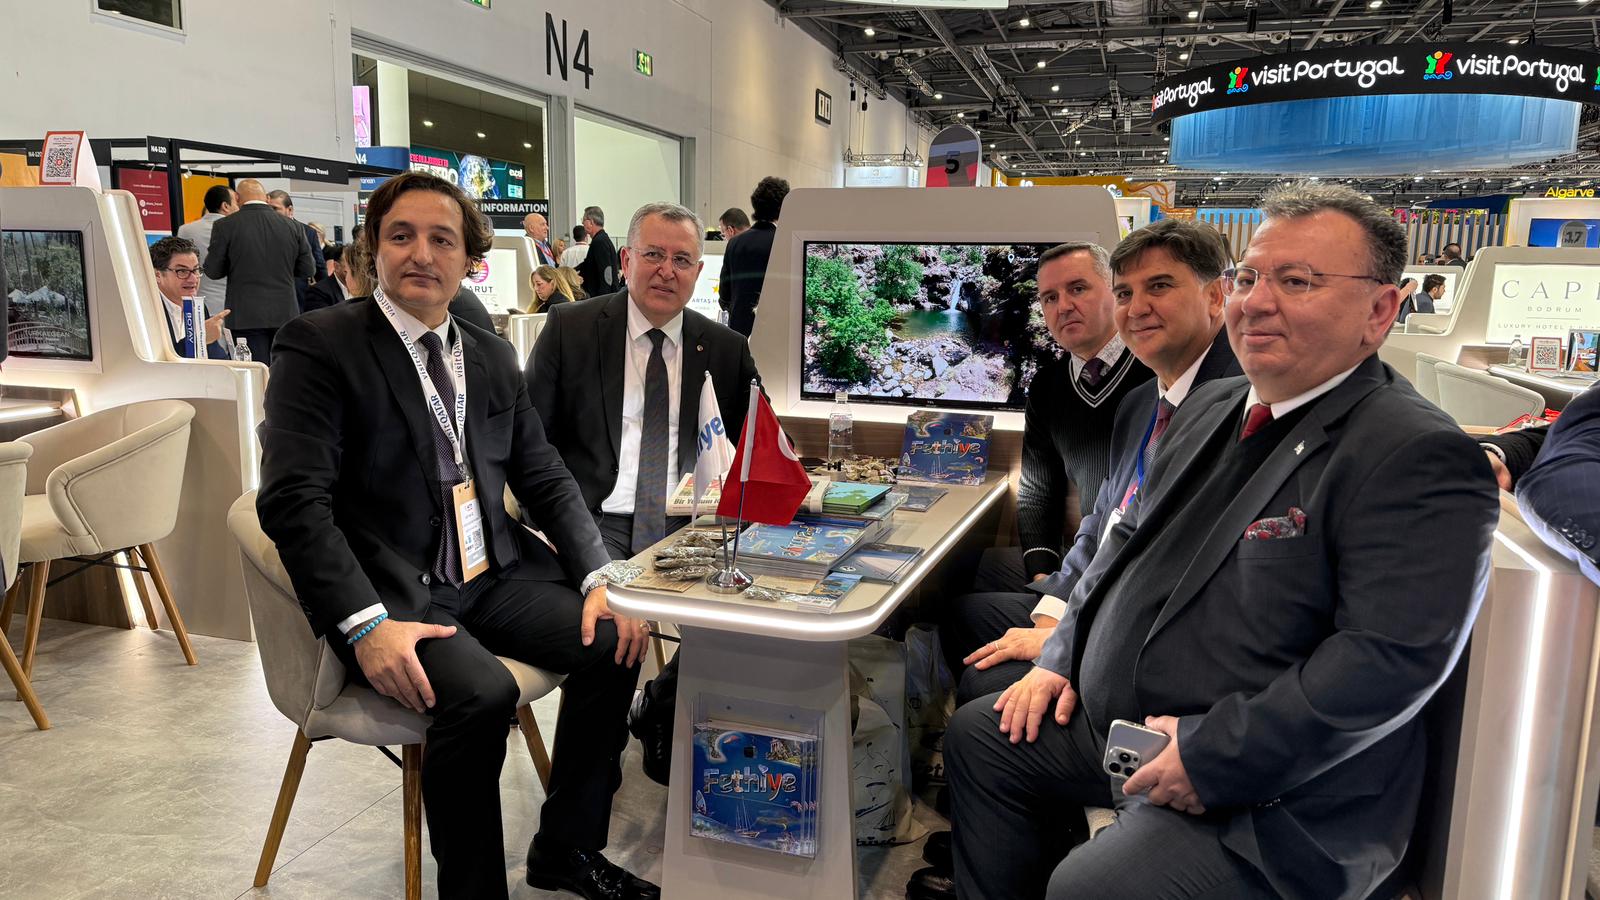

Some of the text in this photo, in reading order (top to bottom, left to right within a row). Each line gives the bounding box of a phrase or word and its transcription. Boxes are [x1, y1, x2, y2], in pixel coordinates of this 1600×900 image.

[546, 12, 594, 90] N4
[1252, 56, 1405, 88] visit Portugal
[1456, 54, 1586, 92] visit Portugal
[1163, 76, 1215, 108] Portugal
[150, 145, 167, 154] N4-120
[944, 150, 961, 174] 5
[481, 203, 547, 213] INFORMATION
[1544, 186, 1595, 198] Algarve
[400, 330, 428, 381] visitQATAR
[430, 394, 456, 444] visitQATAR
[911, 438, 981, 459] Fethiye
[703, 764, 797, 801] Fethiye
